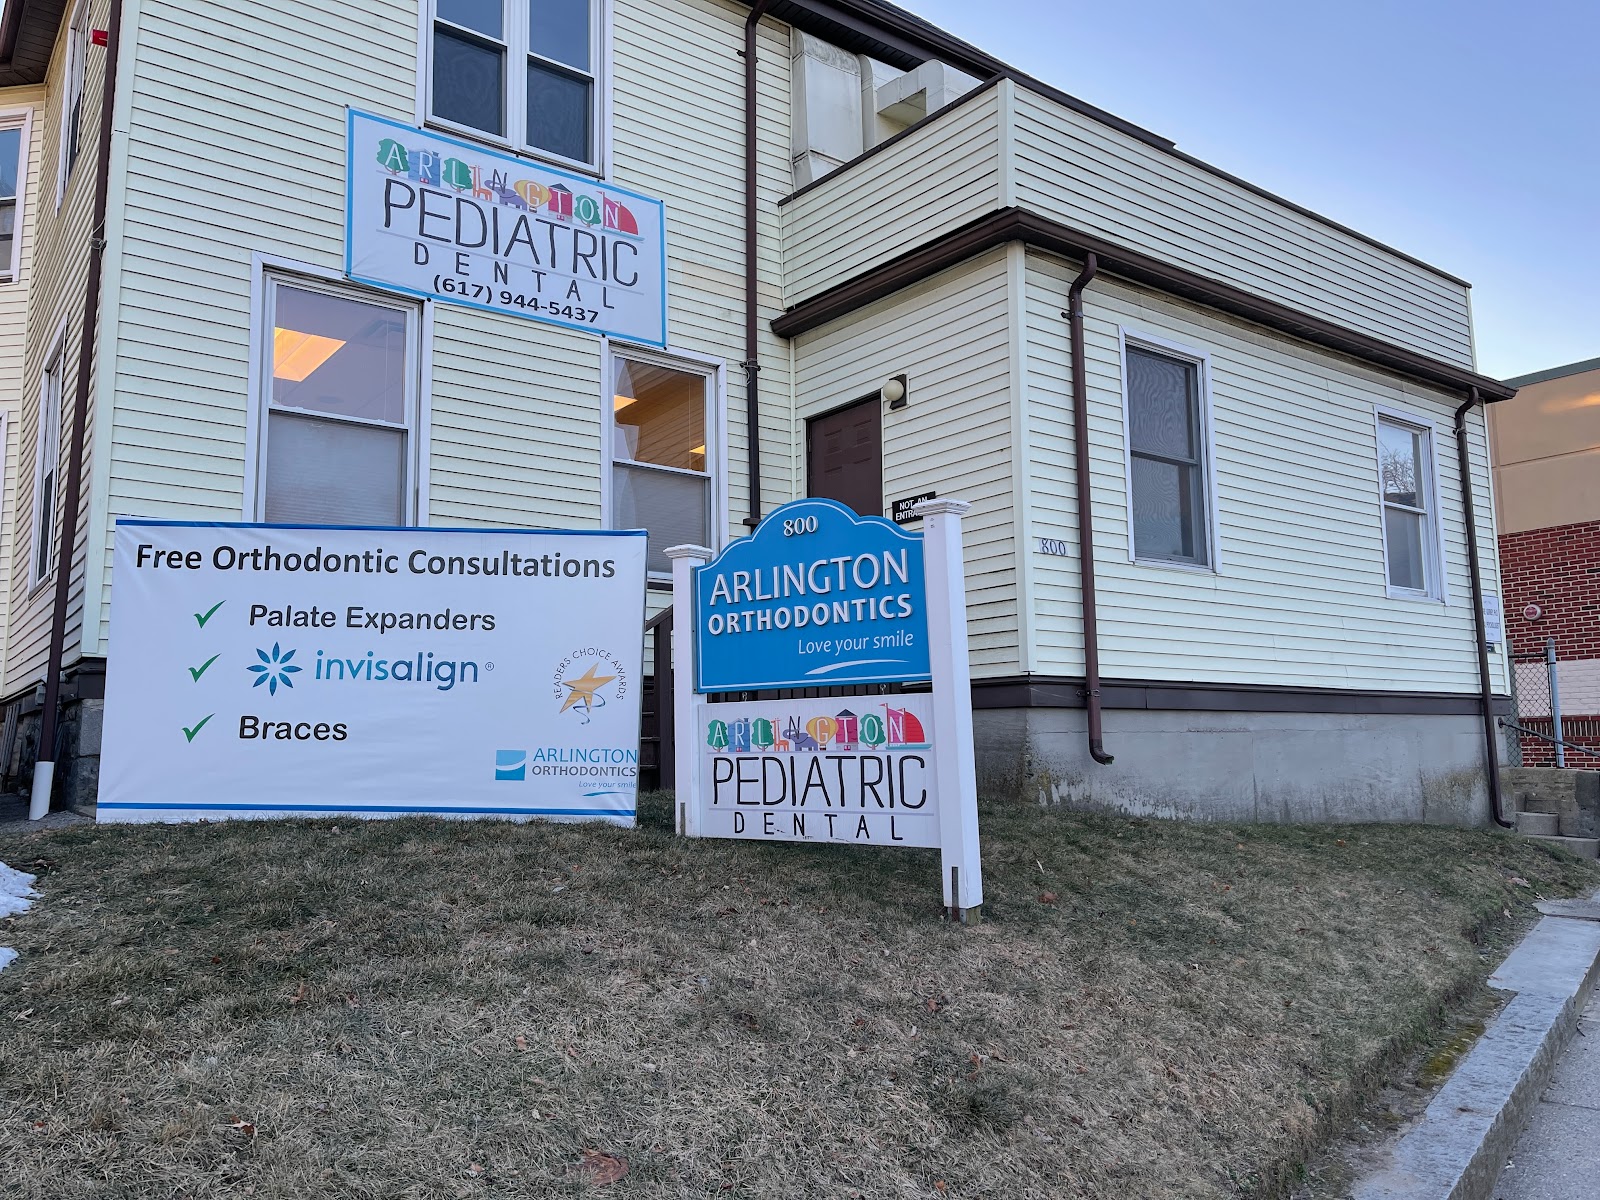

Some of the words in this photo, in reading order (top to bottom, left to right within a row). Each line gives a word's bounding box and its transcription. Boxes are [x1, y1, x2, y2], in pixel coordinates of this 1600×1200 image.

[384, 178, 638, 286] PEDIATRIC
[414, 241, 614, 309] DENTAL
[433, 274, 493, 304] (617)
[500, 290, 599, 324] 944-5437
[895, 510, 919, 521] ENTRA
[899, 500, 914, 510] NOT
[783, 515, 818, 537] 800
[136, 544, 202, 569] Free
[212, 545, 398, 574] Orthodontic
[408, 549, 615, 579] Consultations
[1041, 538, 1067, 557] 800
[709, 548, 910, 606] ARLINGTON
[249, 604, 337, 628] Palate
[346, 606, 496, 634] Expanders
[708, 593, 913, 636] ORTHODONTICS
[798, 639, 831, 654] Love
[835, 637, 869, 656] your
[873, 629, 914, 649] smile
[315, 650, 478, 691] invisalign
[553, 657, 571, 699] READERS
[572, 647, 612, 661] CHOICE
[611, 660, 627, 700] AWARDS
[238, 715, 348, 741] Braces
[533, 747, 638, 763] ARLINGTON
[531, 765, 637, 777] ORTHODONTICS
[578, 780, 597, 788] Love
[598, 781, 616, 789] your
[713, 755, 927, 809] PEDIATRIC
[734, 811, 903, 841] DENTAL
